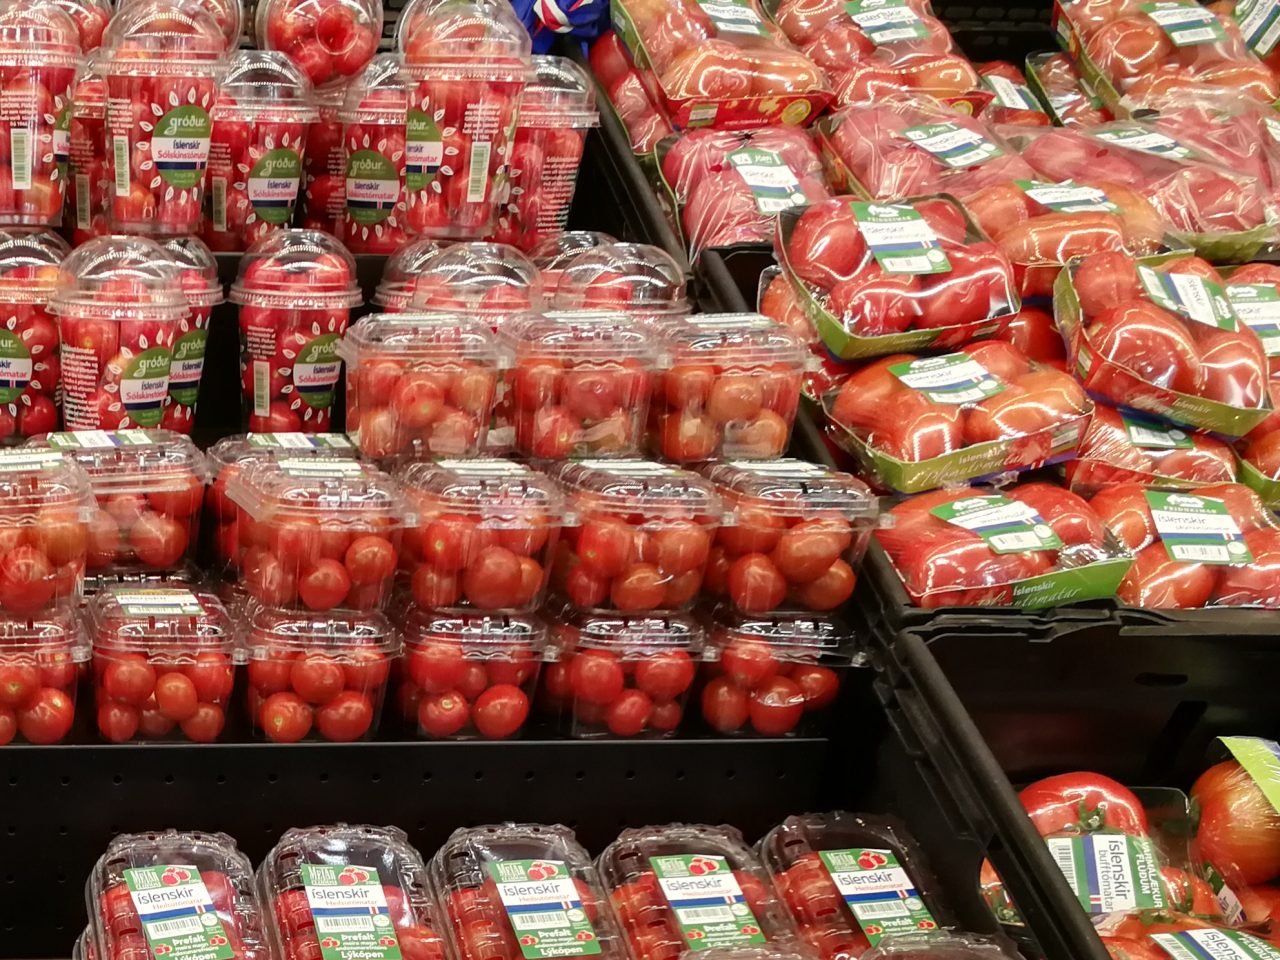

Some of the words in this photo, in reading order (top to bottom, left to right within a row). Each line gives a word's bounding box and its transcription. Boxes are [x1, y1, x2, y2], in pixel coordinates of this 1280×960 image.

[1108, 840, 1130, 899] íslenskir
[666, 877, 723, 891] íslenskir
[837, 872, 894, 885] íslenskir
[1098, 850, 1113, 911] bufftómatar
[137, 887, 194, 905] íslenskir
[311, 888, 370, 900] íslenskir
[503, 883, 560, 897] íslenskir
[172, 935, 205, 946] Þrefalt
[341, 933, 373, 942] Þrefalt
[341, 950, 384, 960] Lýkópen
